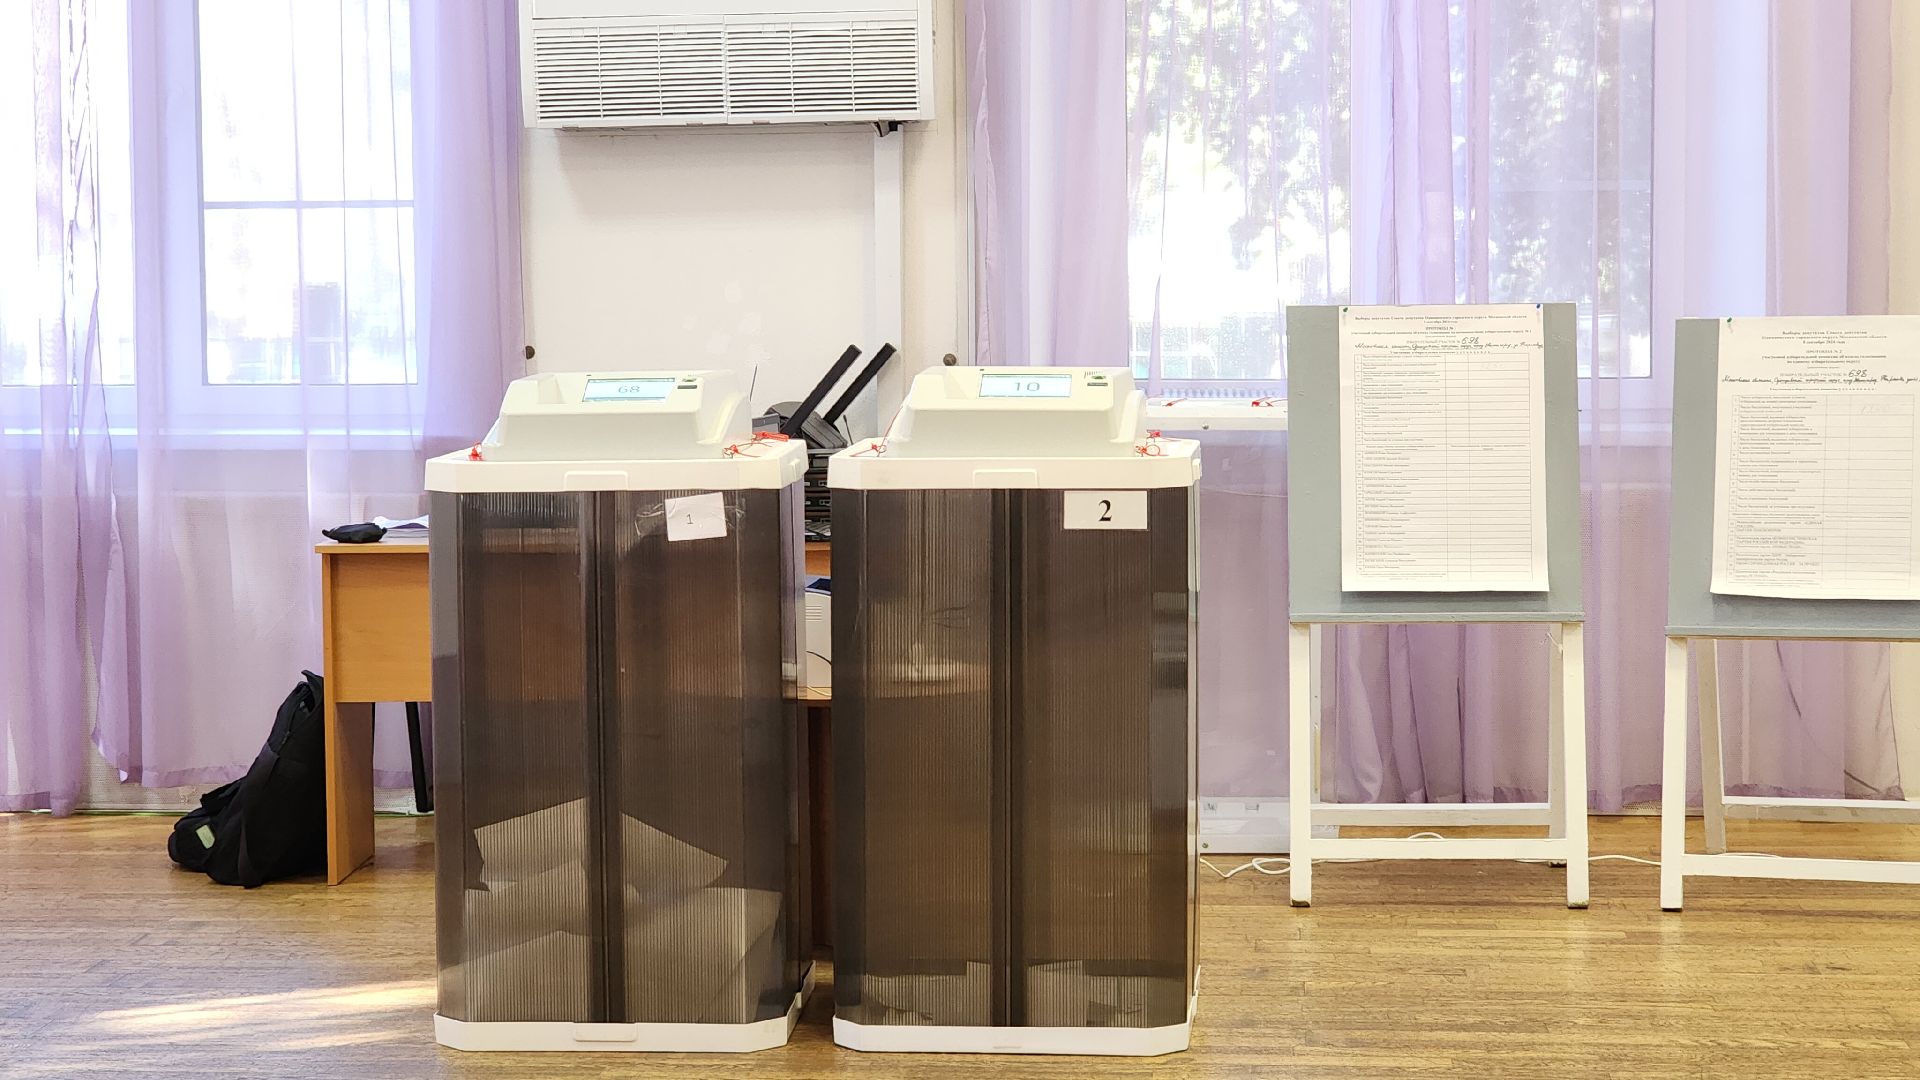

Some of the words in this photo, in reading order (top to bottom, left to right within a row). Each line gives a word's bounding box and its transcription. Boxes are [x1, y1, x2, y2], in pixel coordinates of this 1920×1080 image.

[617, 385, 641, 394] 68
[1014, 381, 1040, 392] 10
[1098, 499, 1113, 522] 2
[686, 513, 694, 525] 1
